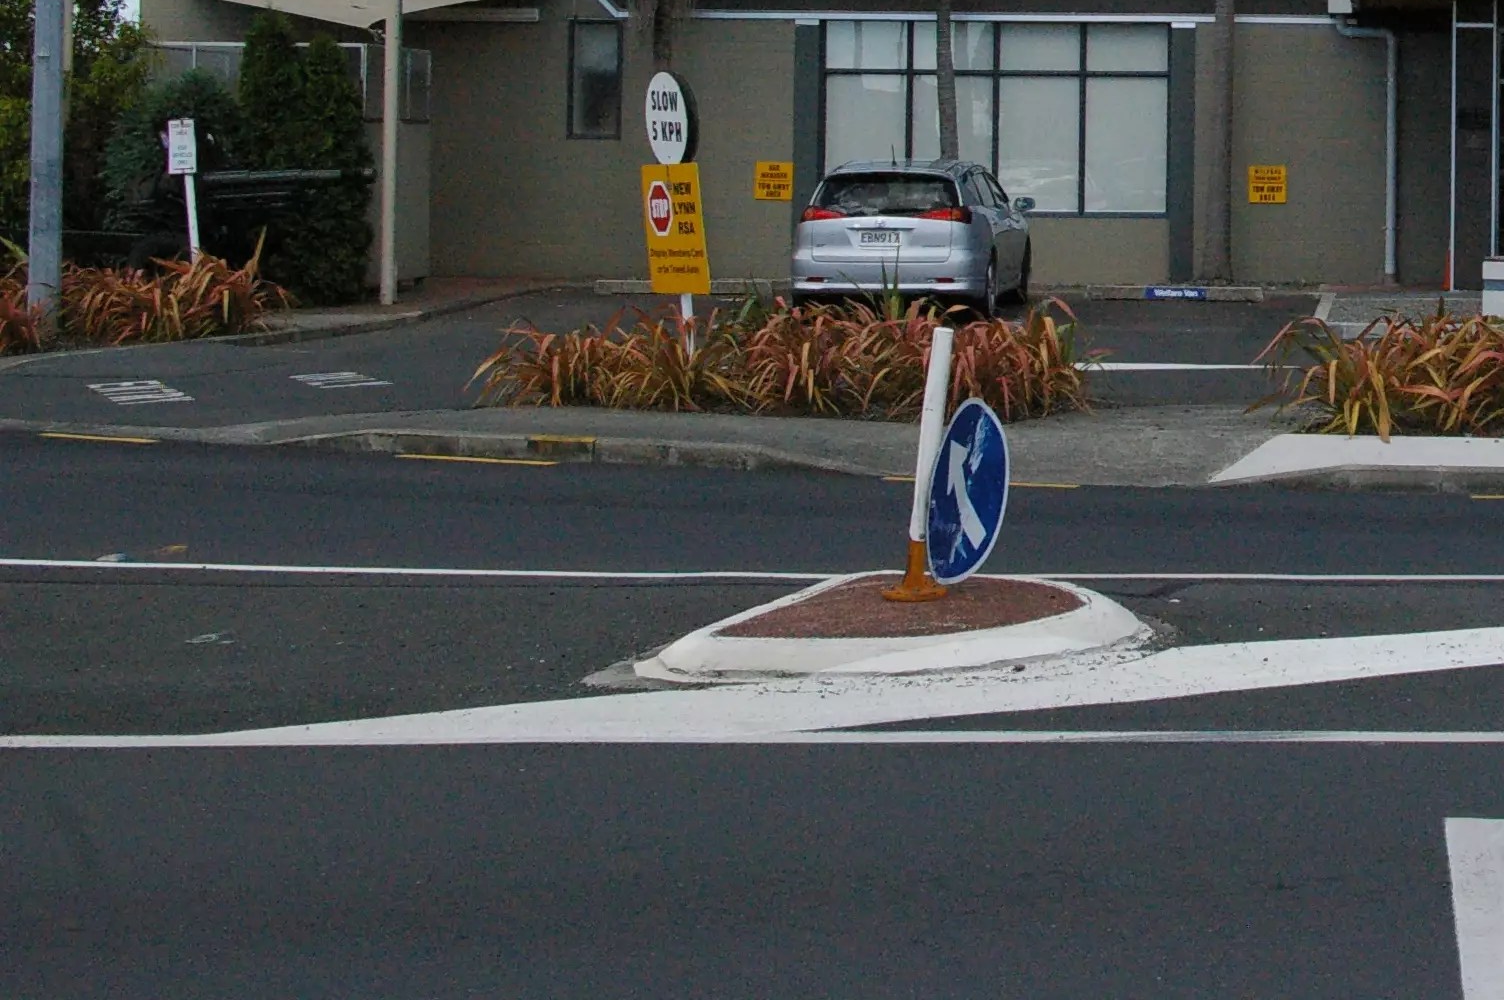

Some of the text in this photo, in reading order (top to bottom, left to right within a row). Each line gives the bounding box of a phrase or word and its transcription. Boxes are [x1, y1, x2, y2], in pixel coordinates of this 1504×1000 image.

[651, 90, 678, 112] SLOW
[652, 120, 682, 142] 5 KPH
[673, 182, 692, 196] NEW
[673, 202, 696, 215] LYNN
[678, 221, 695, 235] RSA
